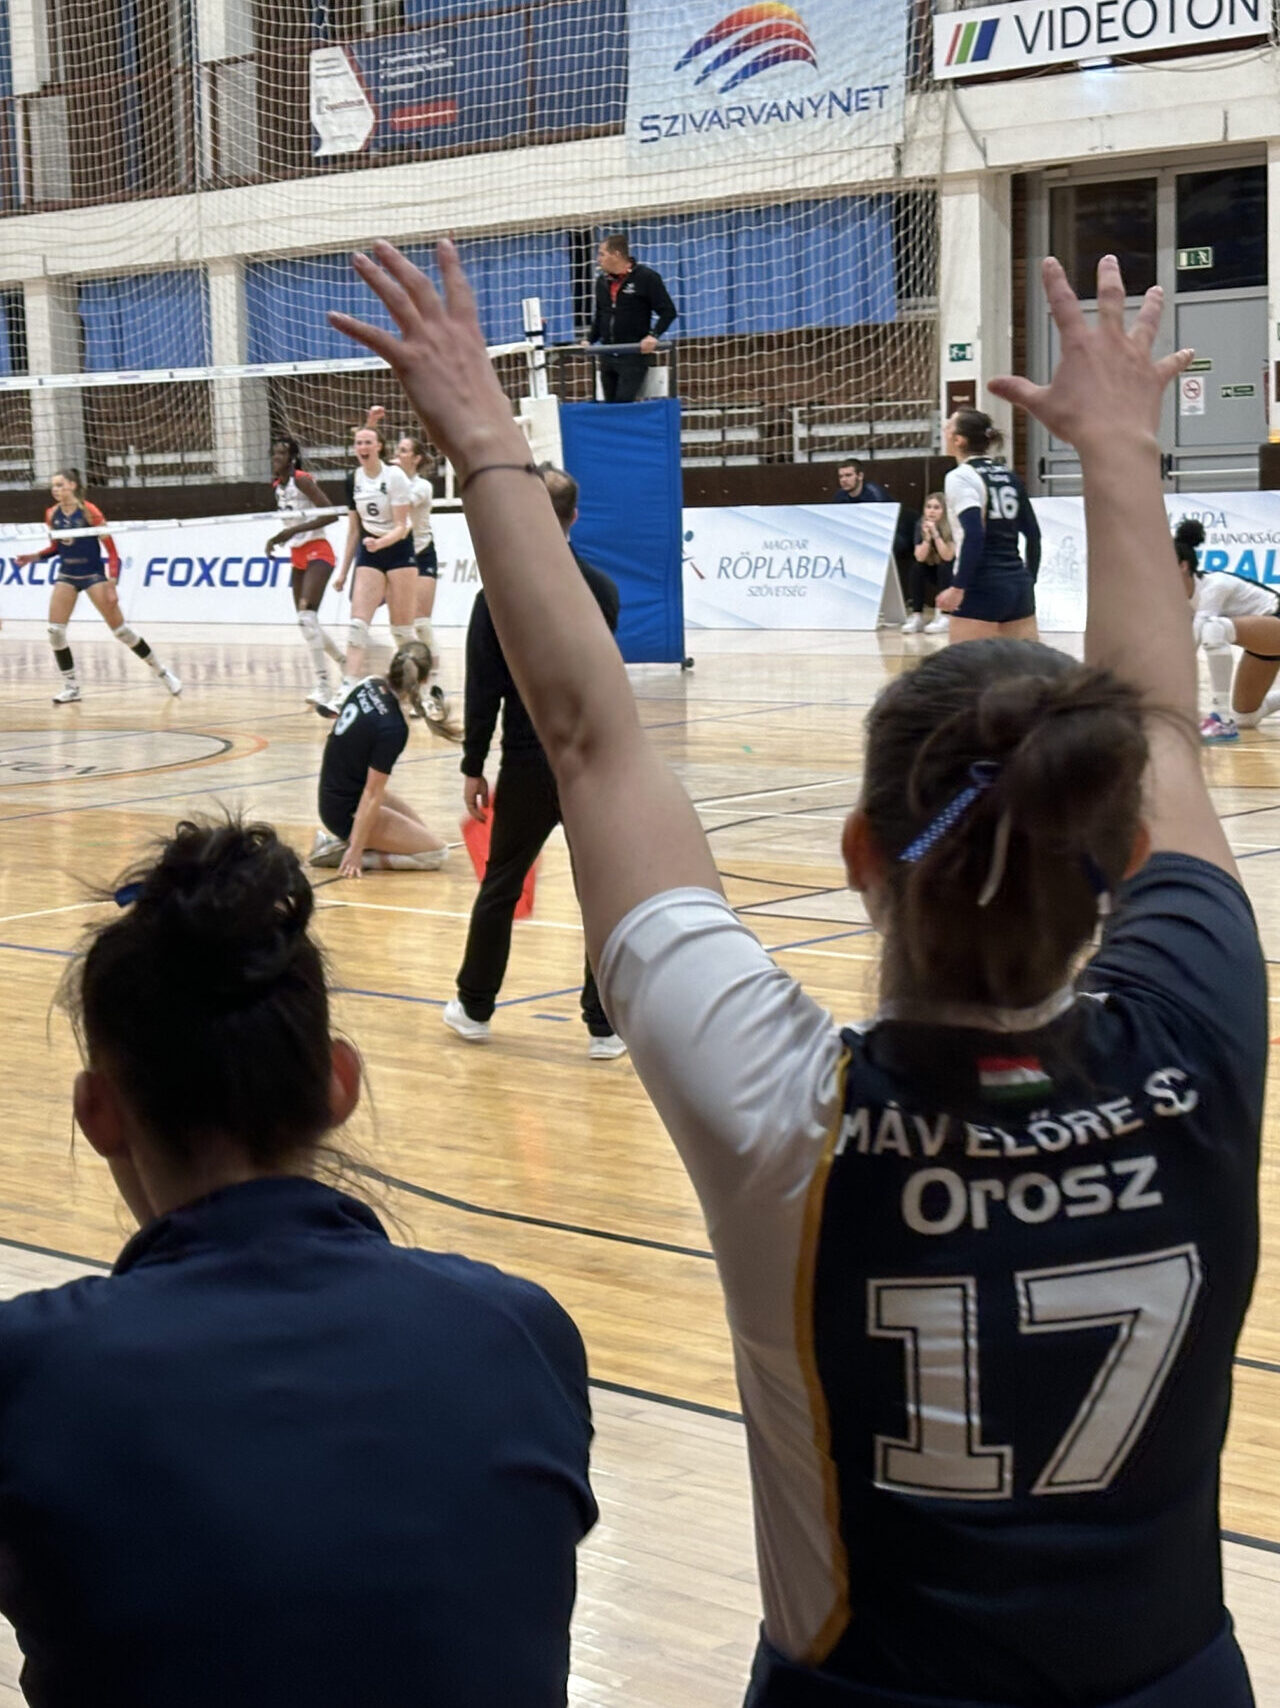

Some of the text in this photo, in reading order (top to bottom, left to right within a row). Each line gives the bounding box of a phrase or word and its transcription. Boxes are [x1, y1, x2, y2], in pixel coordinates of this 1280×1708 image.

[1014, 0, 1261, 54] VIDEOTON
[366, 502, 380, 517] 6
[988, 486, 1019, 519] 16
[144, 557, 295, 587] FOXCON
[717, 551, 847, 580] RÖPLABDA
[835, 1100, 950, 1157] MÁV
[901, 1156, 1164, 1236] Orosz
[866, 1242, 1203, 1500] 17
